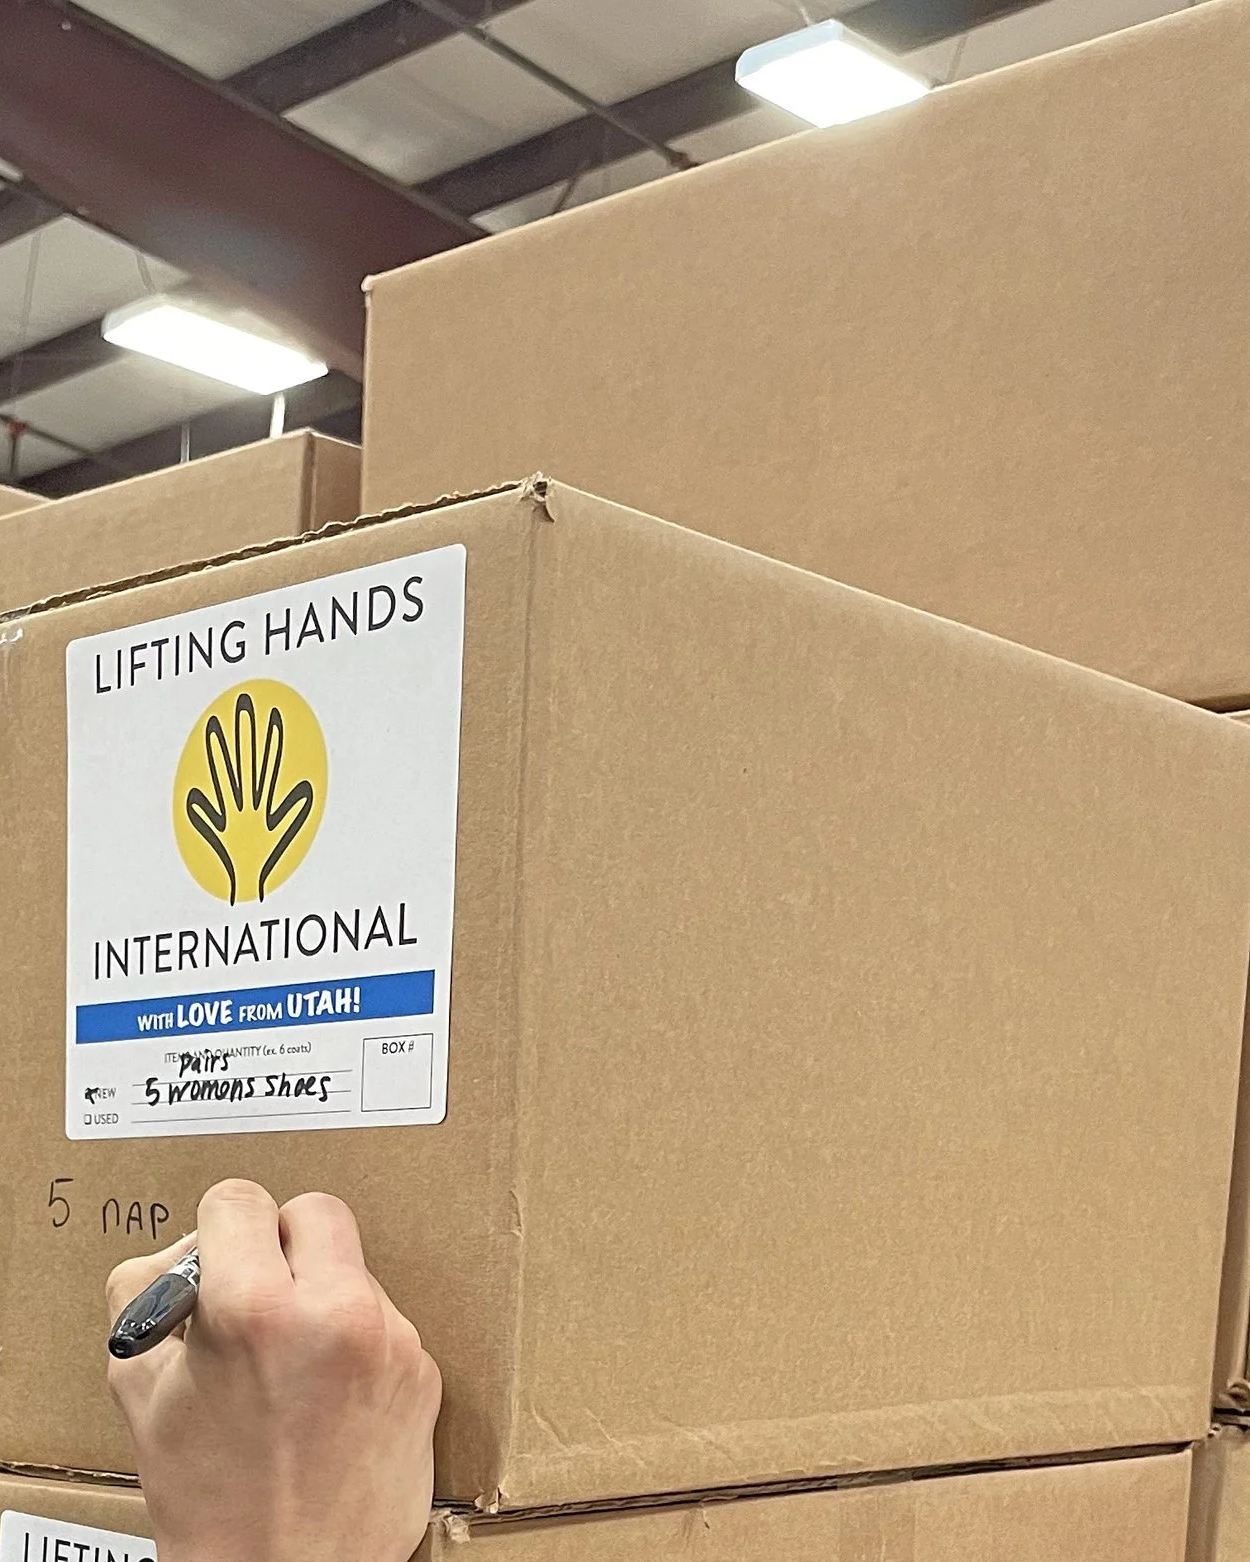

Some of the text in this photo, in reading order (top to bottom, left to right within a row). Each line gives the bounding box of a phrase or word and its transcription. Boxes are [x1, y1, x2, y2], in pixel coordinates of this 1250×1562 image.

[95, 575, 425, 695] LIFTING HANDS
[93, 902, 418, 980] INTERNATIONAL
[137, 986, 361, 1031] WITH LOVE FROM UTAH!
[279, 1043, 286, 1055] 6
[381, 1041, 406, 1055] BOX
[145, 1077, 160, 1106] 5
[94, 1113, 120, 1125] USED
[47, 1177, 74, 1229] 5
